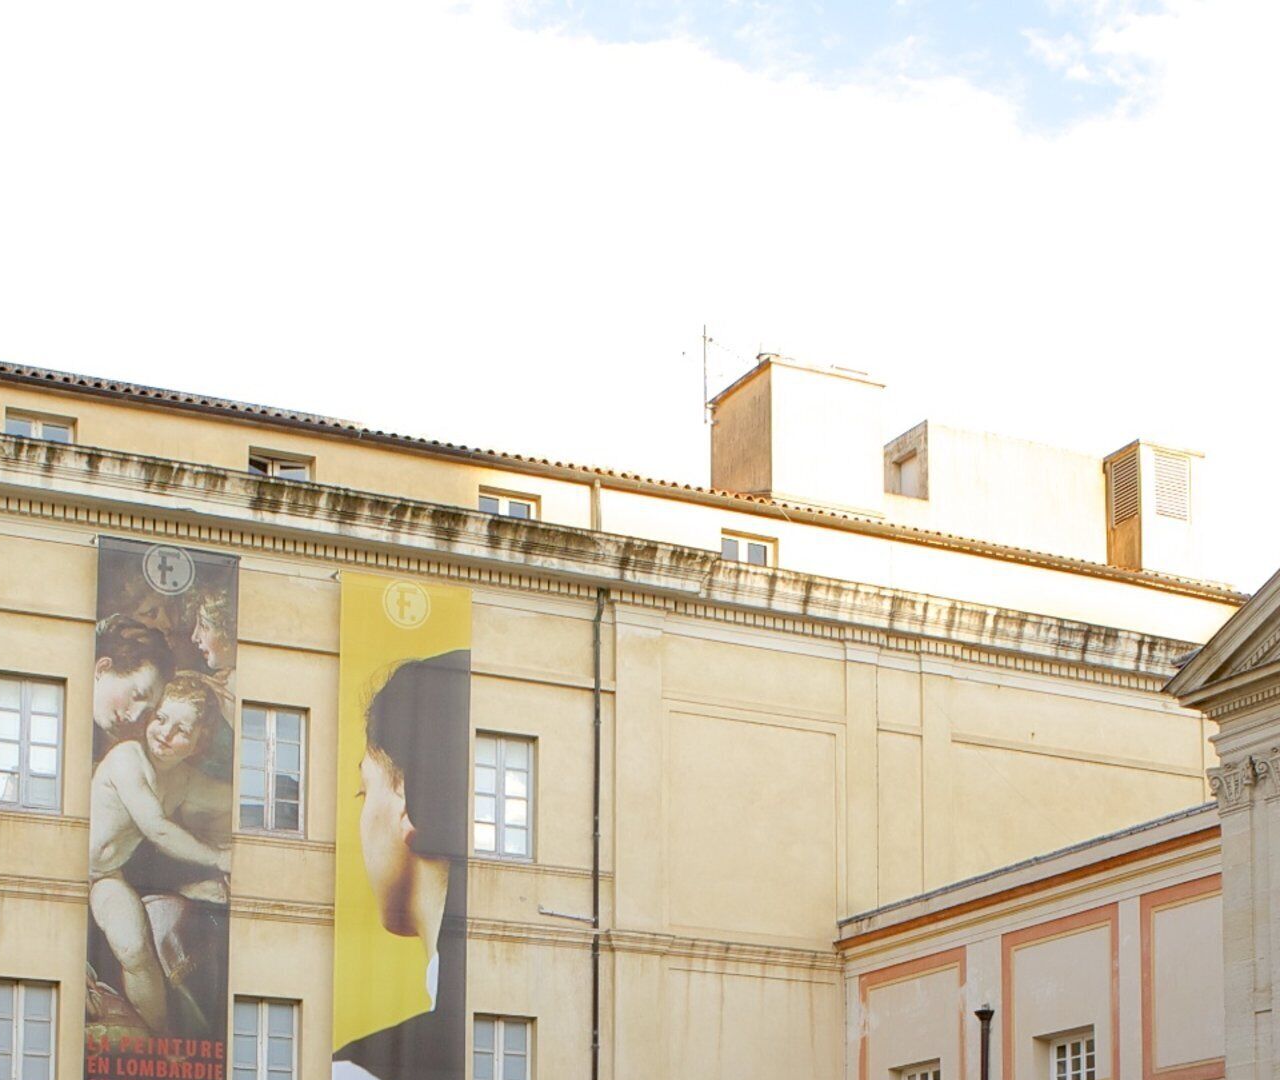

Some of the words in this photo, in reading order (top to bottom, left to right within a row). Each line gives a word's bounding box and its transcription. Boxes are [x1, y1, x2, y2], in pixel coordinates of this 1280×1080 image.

[86, 1033, 111, 1053] LA
[120, 1035, 224, 1059] PEINTURE
[87, 1056, 110, 1075] EN
[116, 1057, 223, 1080] LOMBARDIE
